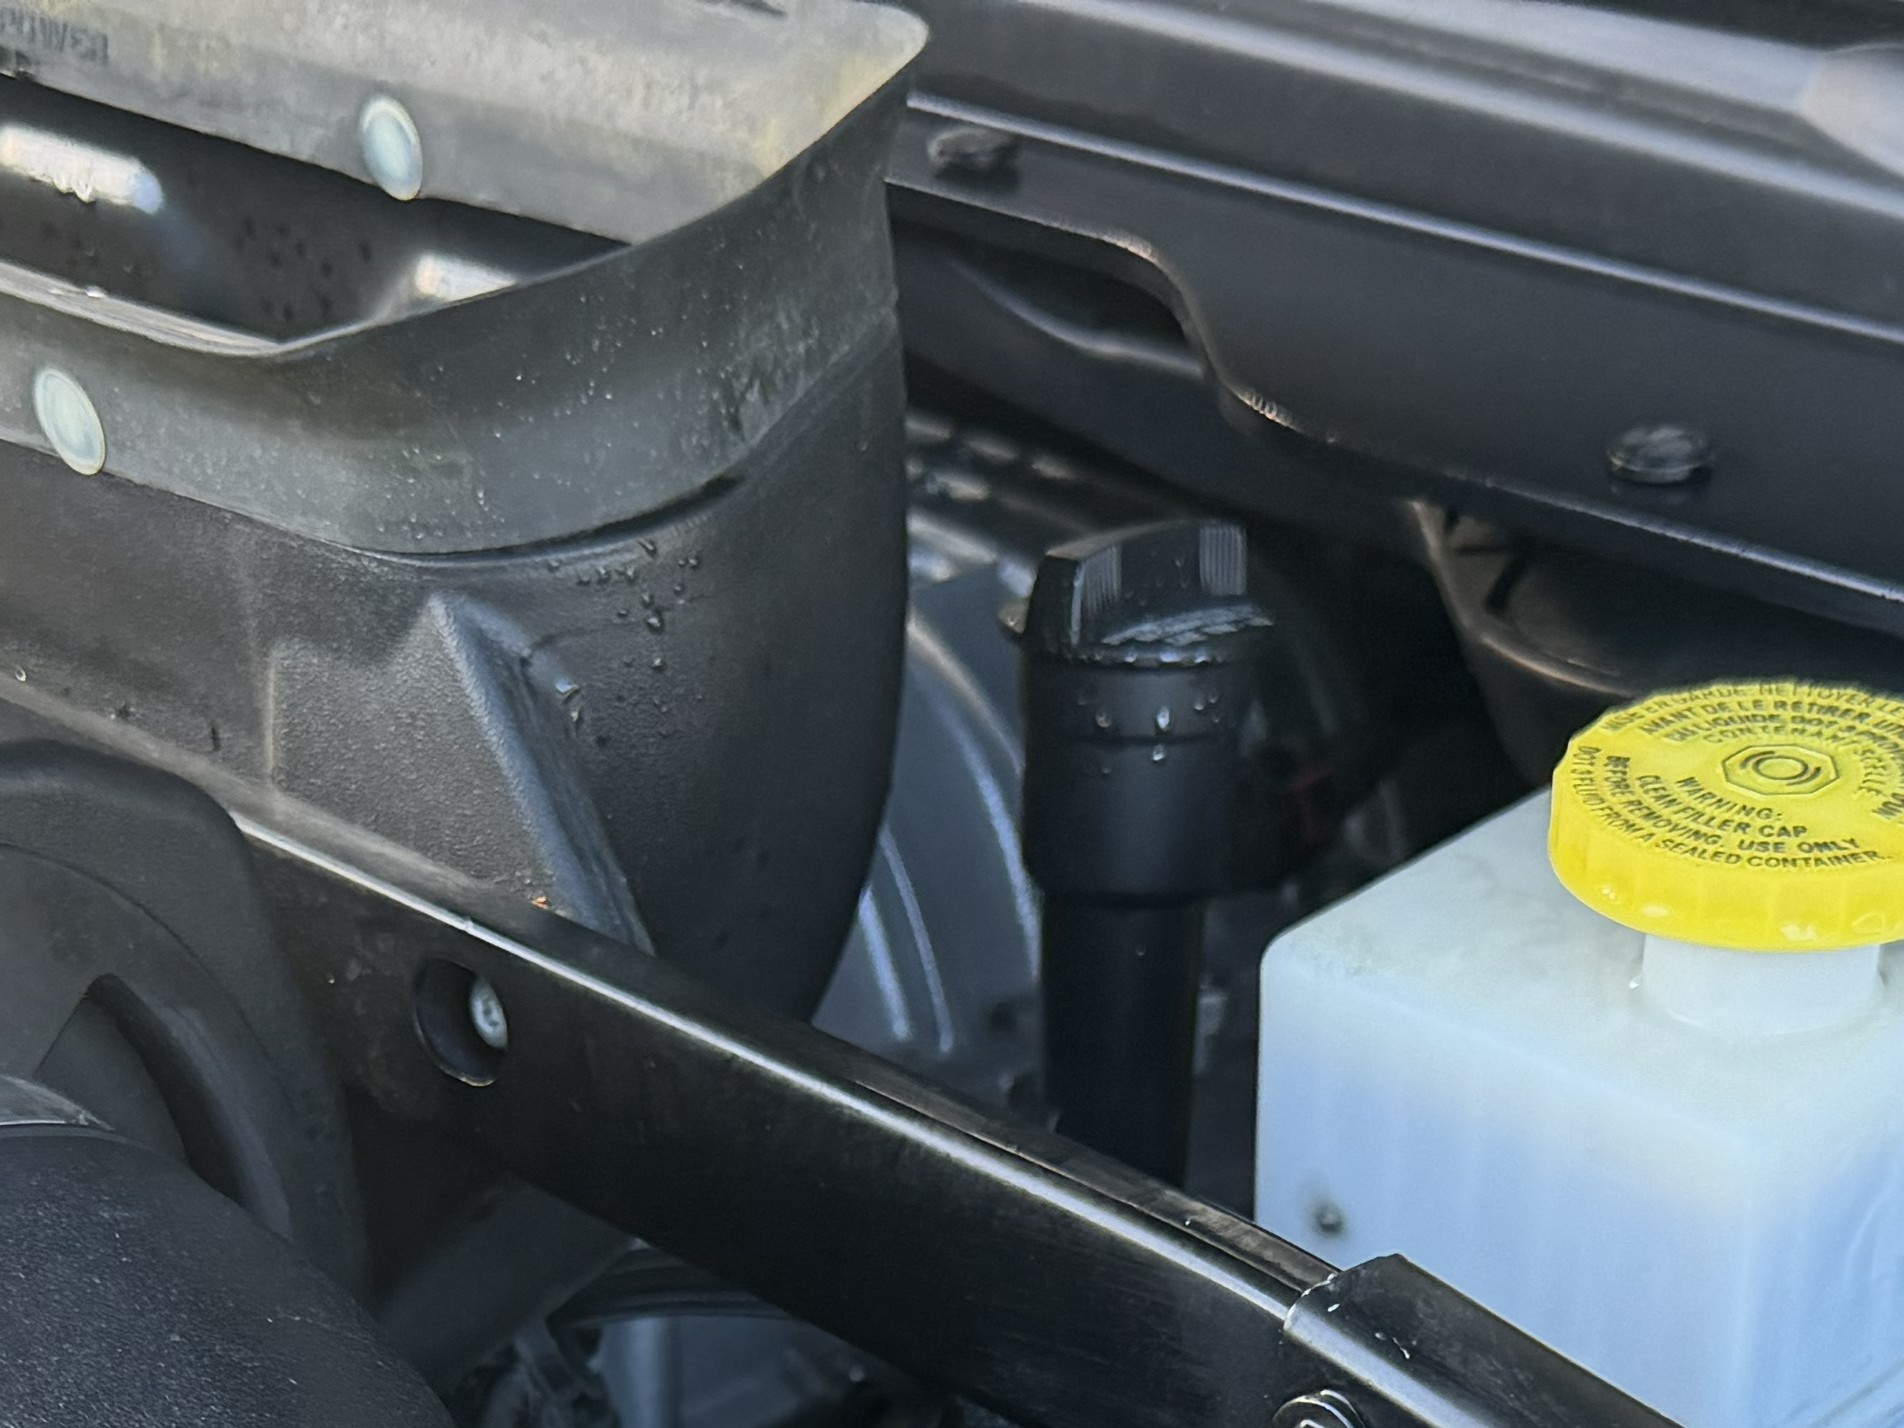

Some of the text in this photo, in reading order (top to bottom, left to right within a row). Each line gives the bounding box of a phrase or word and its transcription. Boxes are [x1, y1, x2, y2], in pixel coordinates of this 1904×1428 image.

[1701, 701, 1733, 715] DE
[1737, 699, 1765, 712] LE
[1572, 745, 1602, 766] DOT
[1572, 777, 1607, 806] FLUID
[1603, 755, 1861, 854] BEFORE REMOVING. USE ONLY
[1636, 774, 1808, 838] CLEAN FILLER CAP
[1675, 776, 1783, 821] WARNING:
[1589, 805, 1646, 834] FROM
[1635, 832, 1657, 843] A
[1654, 838, 1743, 865] SEALED
